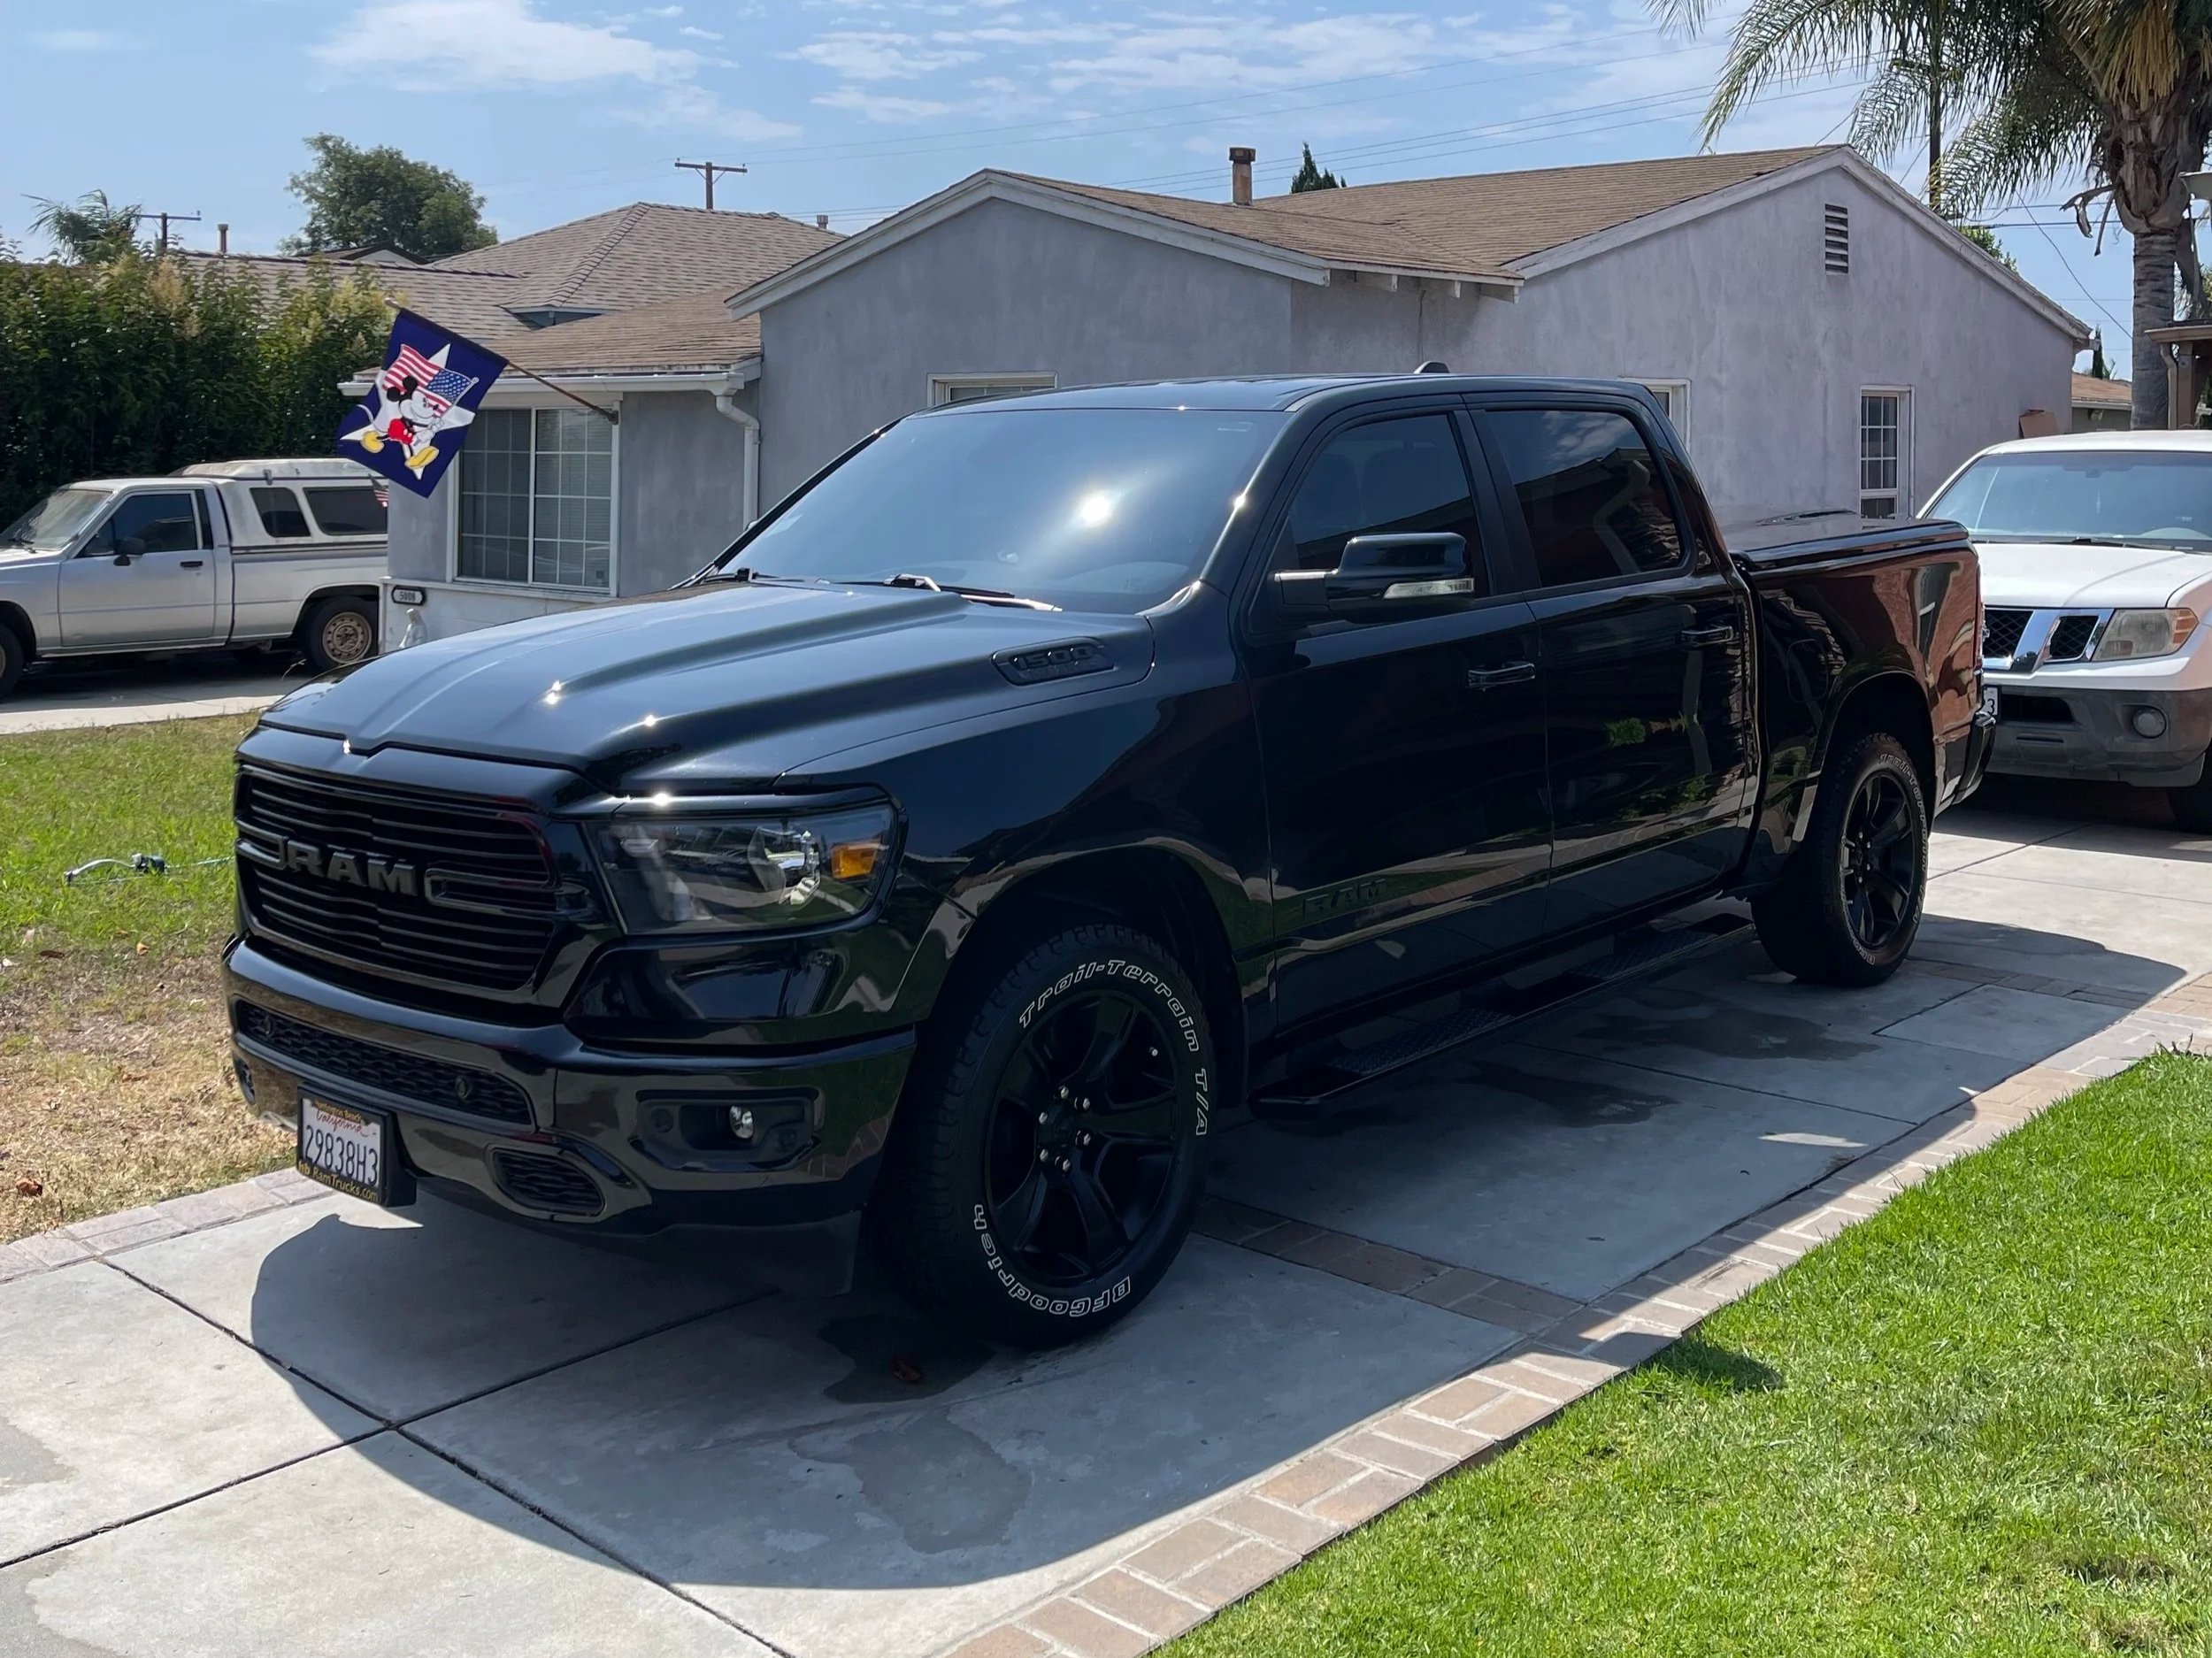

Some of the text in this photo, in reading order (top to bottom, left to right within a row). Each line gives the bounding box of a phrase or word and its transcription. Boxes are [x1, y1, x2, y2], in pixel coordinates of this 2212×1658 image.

[1012, 644, 1095, 671] 1500
[287, 840, 419, 896] RAM
[1019, 959, 1209, 1136] Trail-Terrain T/A
[304, 1125, 379, 1186] 29838H3
[974, 1204, 1132, 1317] BFGoodrich
